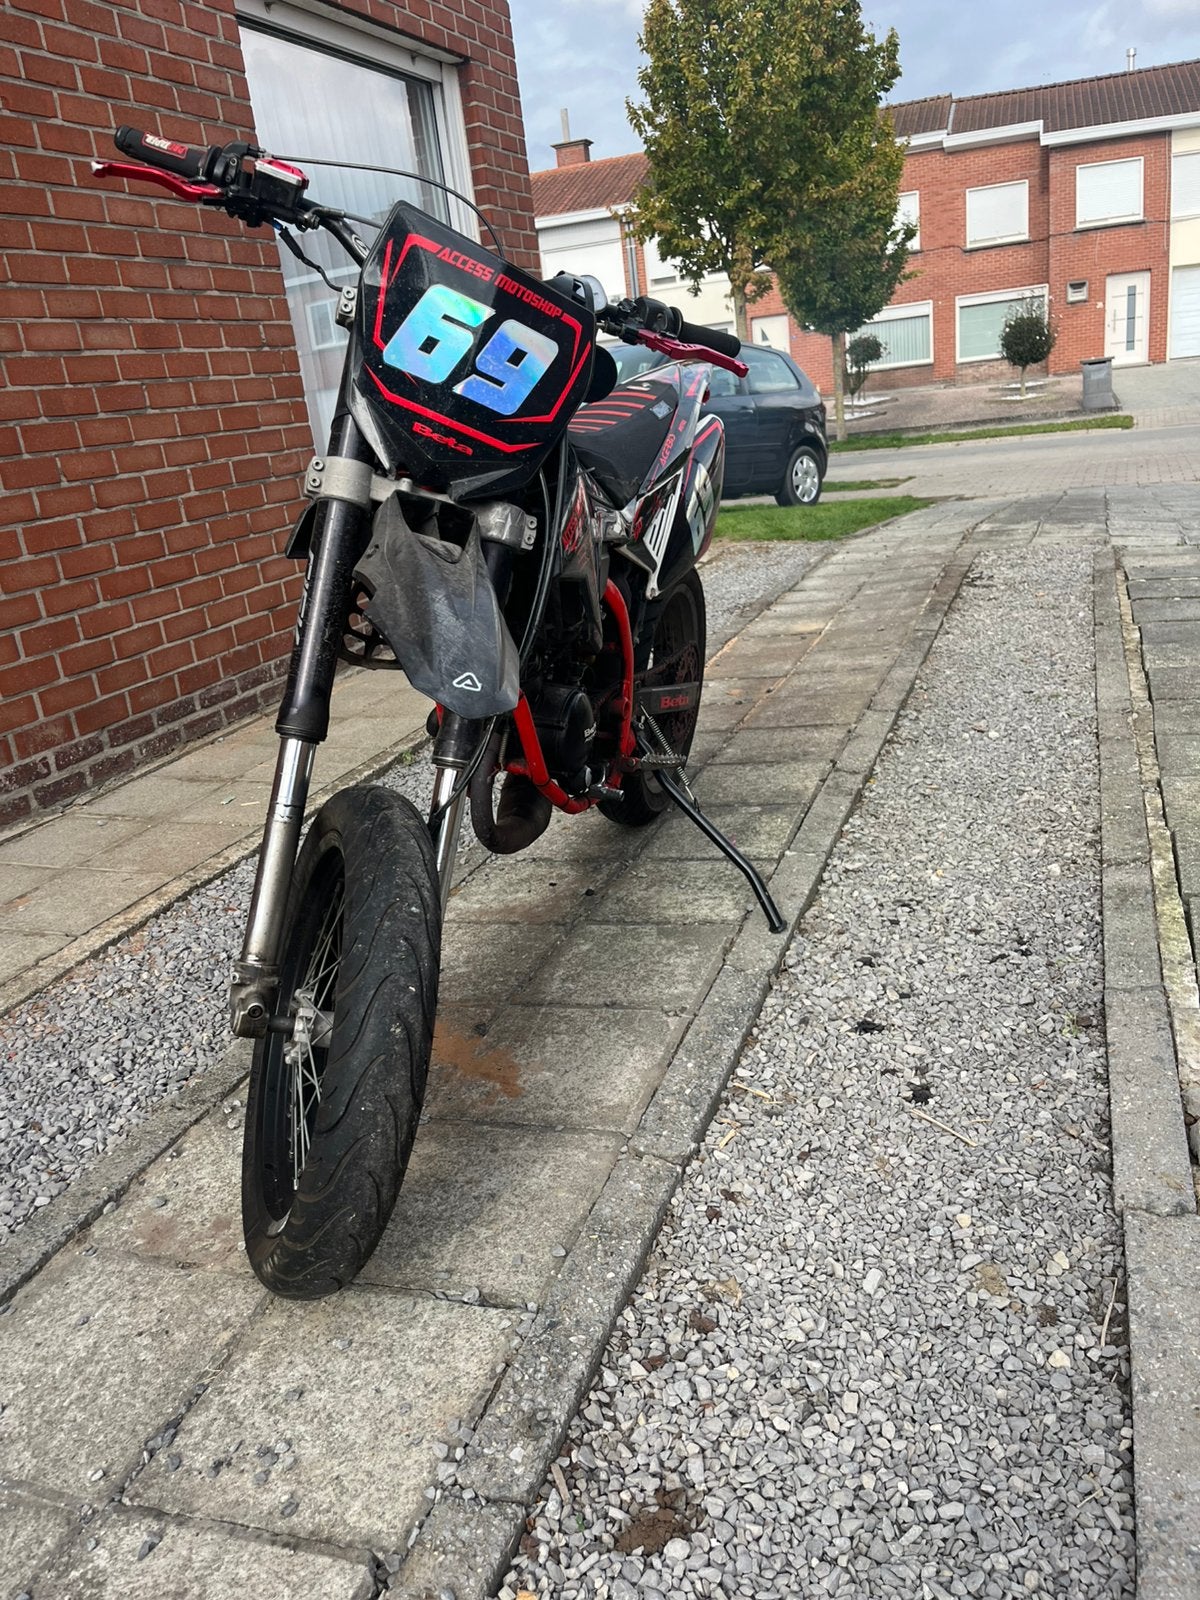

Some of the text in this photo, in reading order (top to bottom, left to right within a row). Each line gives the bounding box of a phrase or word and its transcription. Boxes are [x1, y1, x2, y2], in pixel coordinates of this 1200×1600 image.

[437, 247, 563, 318] ACCESS MOTOSHOP
[383, 283, 559, 415] 69
[412, 421, 473, 456] Beta
